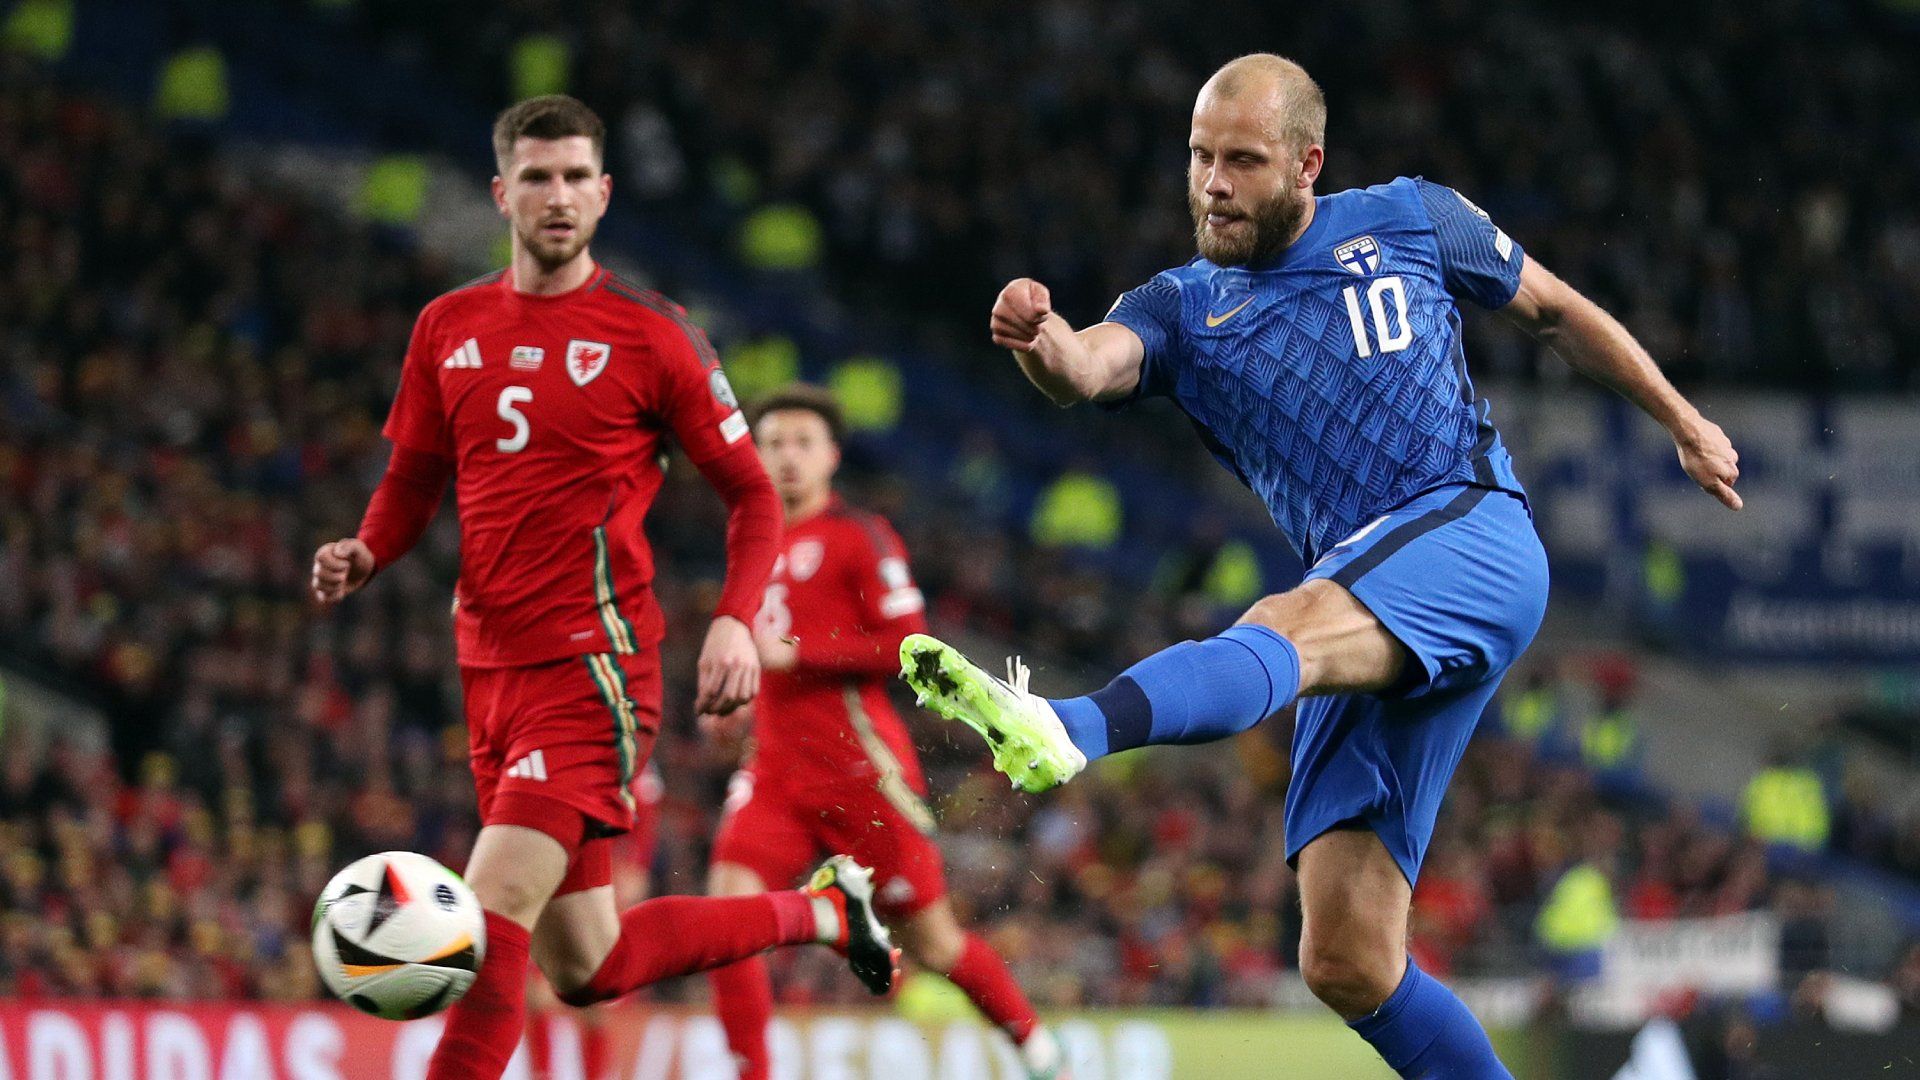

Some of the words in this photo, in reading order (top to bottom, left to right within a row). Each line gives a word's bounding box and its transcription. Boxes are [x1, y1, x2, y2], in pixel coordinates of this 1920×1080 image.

[1343, 276, 1413, 359] 10
[496, 385, 534, 453] 5
[0, 1010, 347, 1080] DIDAS
